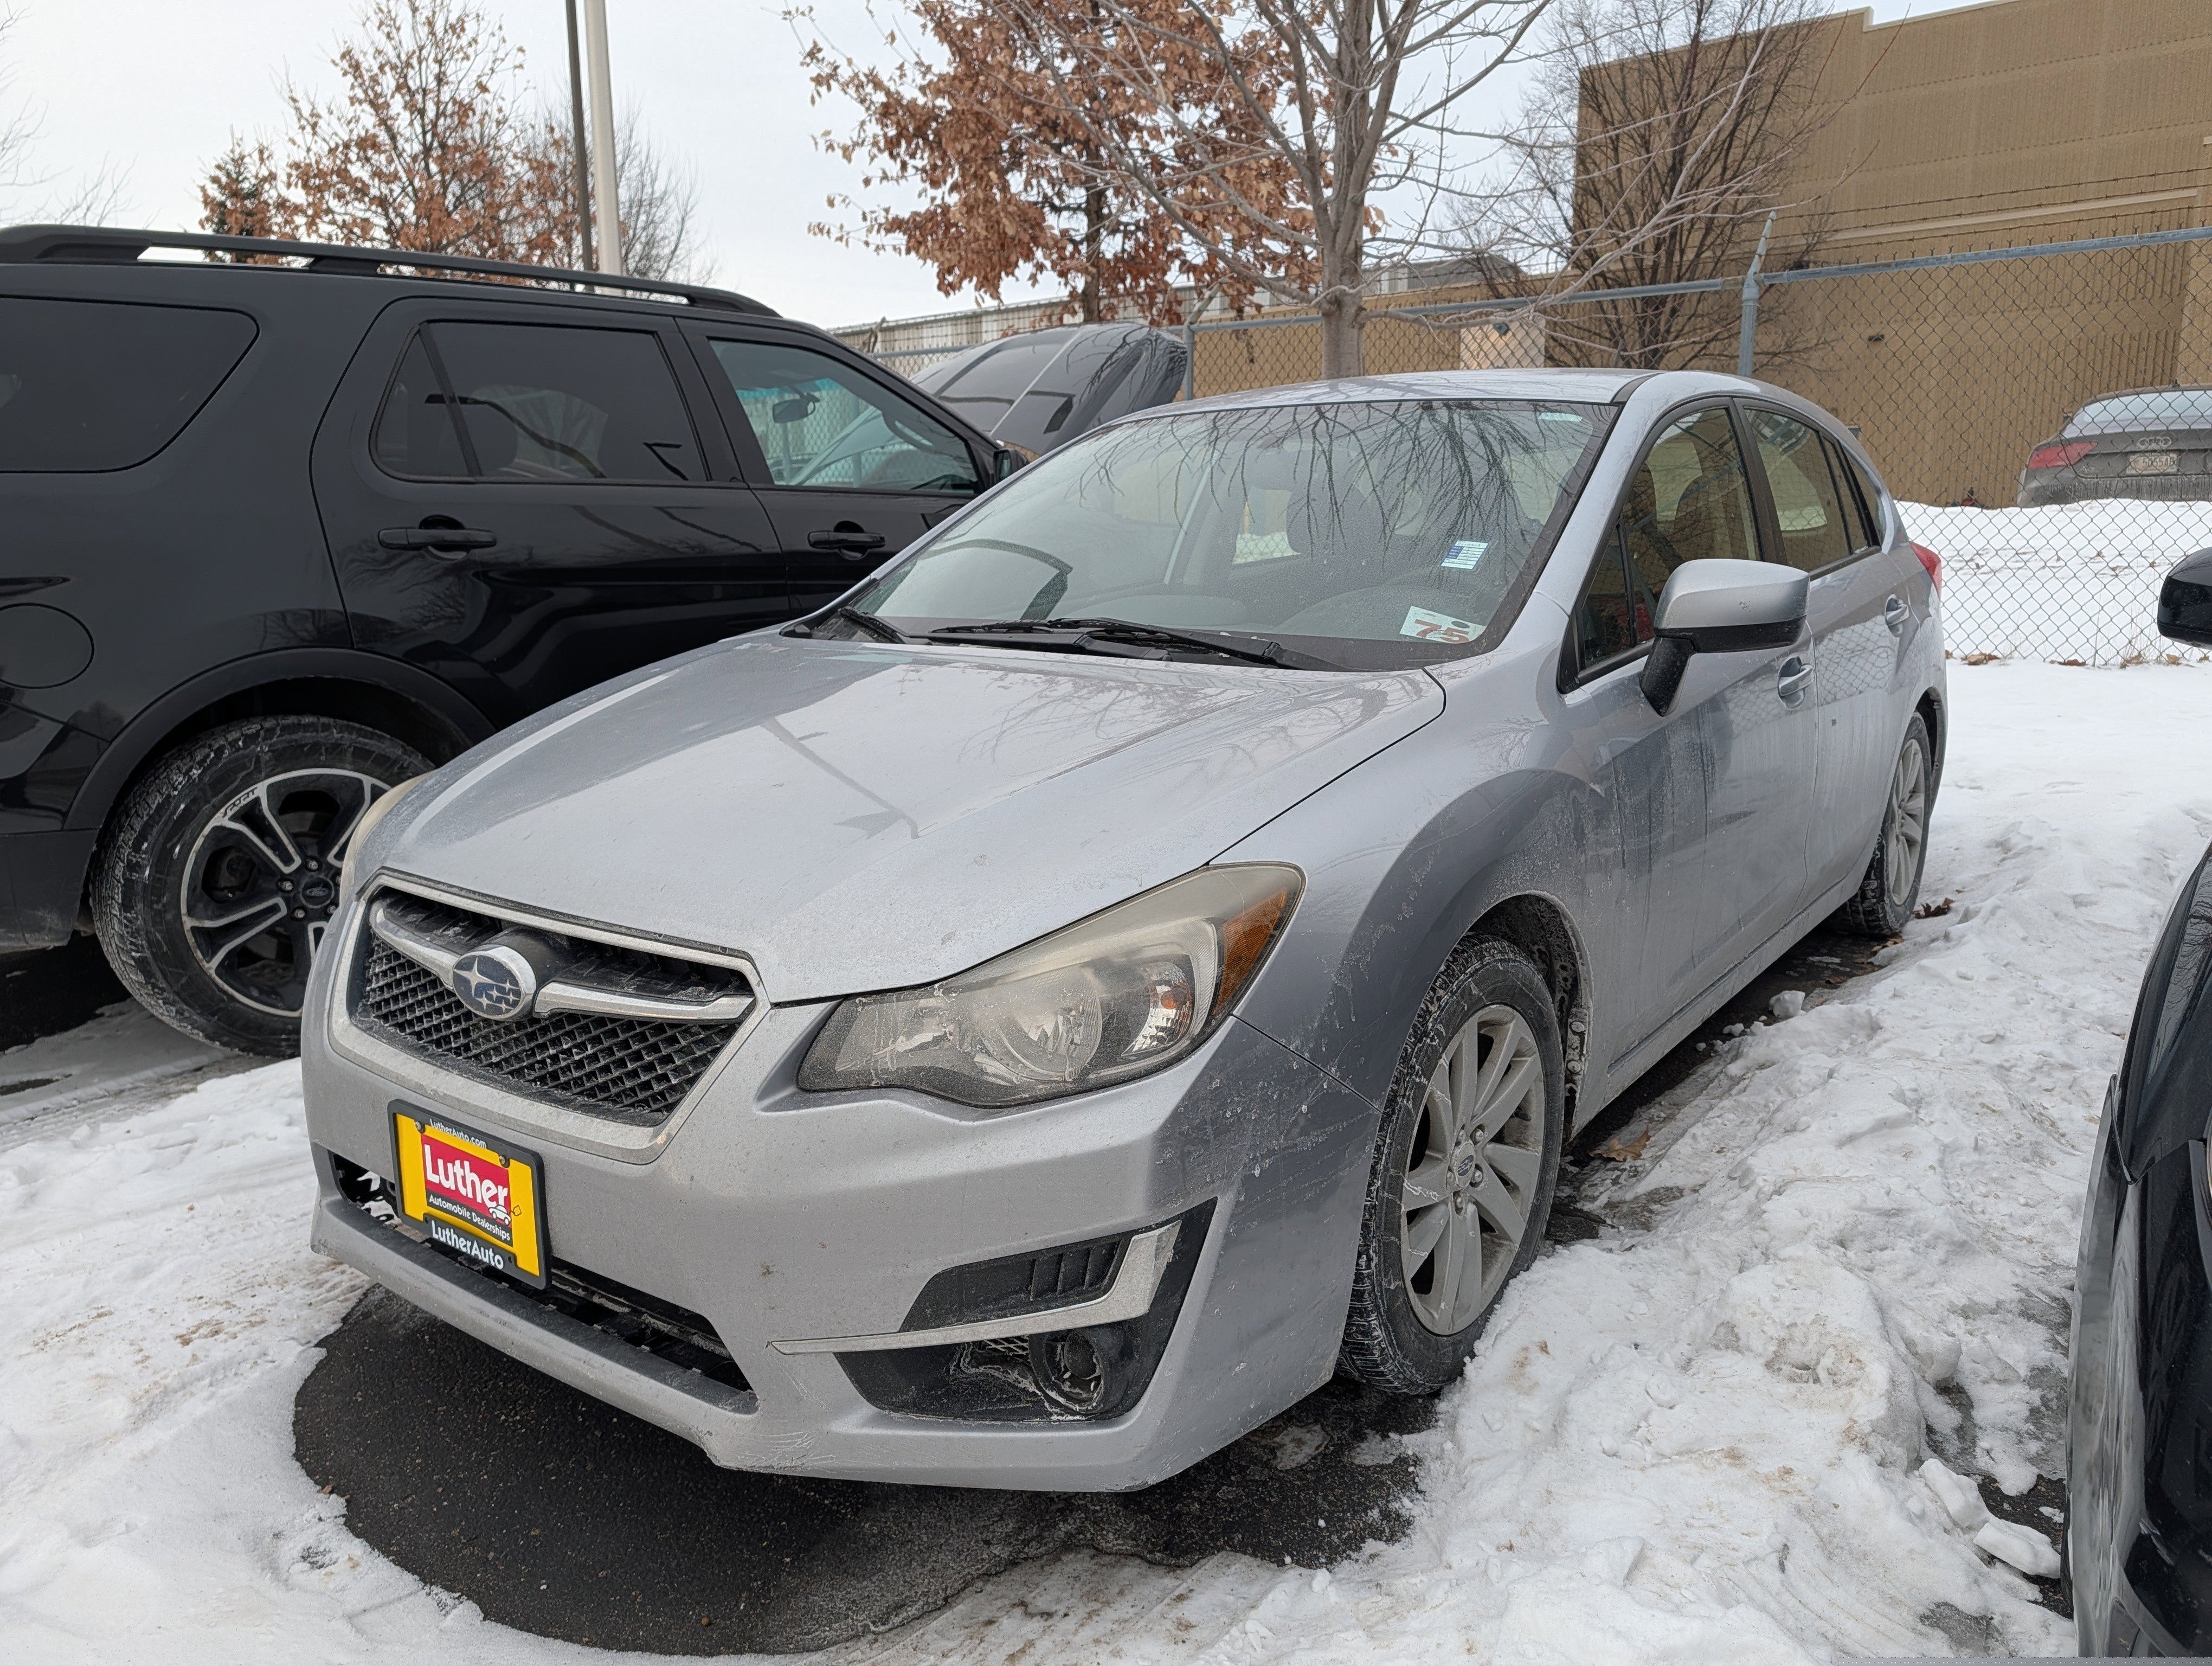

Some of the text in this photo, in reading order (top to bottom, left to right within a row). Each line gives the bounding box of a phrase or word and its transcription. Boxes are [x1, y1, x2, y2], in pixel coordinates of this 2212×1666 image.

[1414, 619, 1469, 644] 75
[429, 1118, 487, 1150] LutherAuto.com
[423, 1143, 509, 1209] Luther
[428, 1194, 511, 1241] Automobile Dealerships
[431, 1220, 505, 1270] LutherAuto
